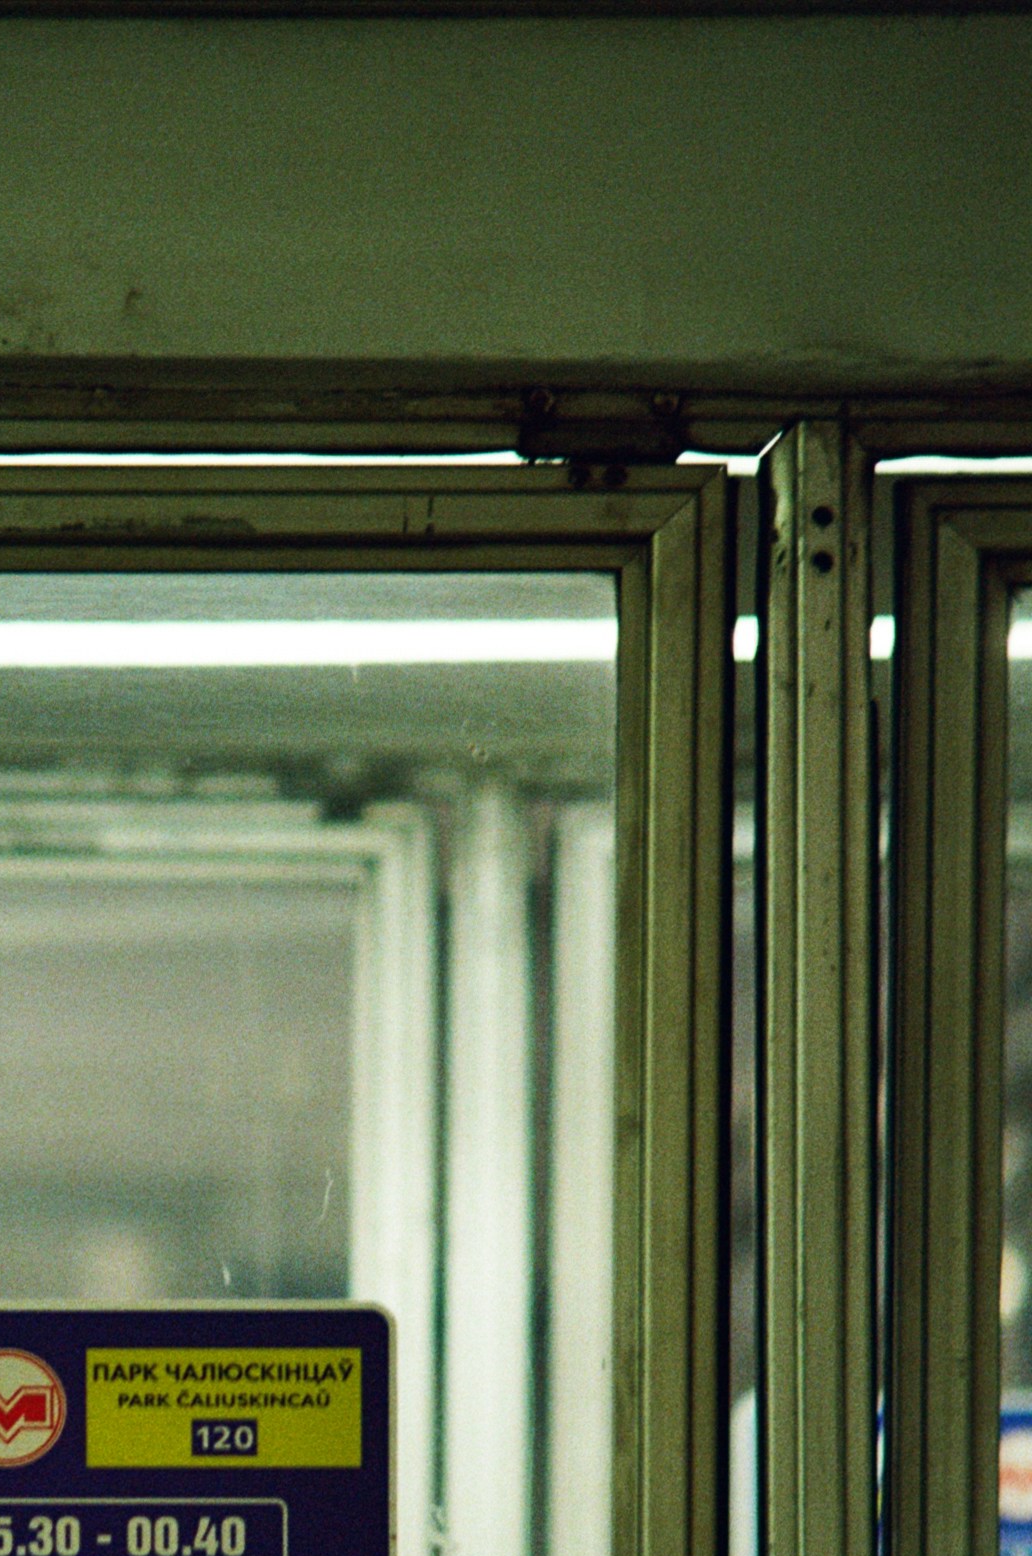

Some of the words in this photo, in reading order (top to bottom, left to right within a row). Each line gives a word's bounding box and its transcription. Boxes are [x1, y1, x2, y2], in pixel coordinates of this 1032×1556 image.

[92, 1363, 158, 1382] ПАРК
[164, 1358, 355, 1385] ЧАЛЮСКІНЦАЎ
[117, 1393, 170, 1409] PARK
[196, 1426, 255, 1451] 120
